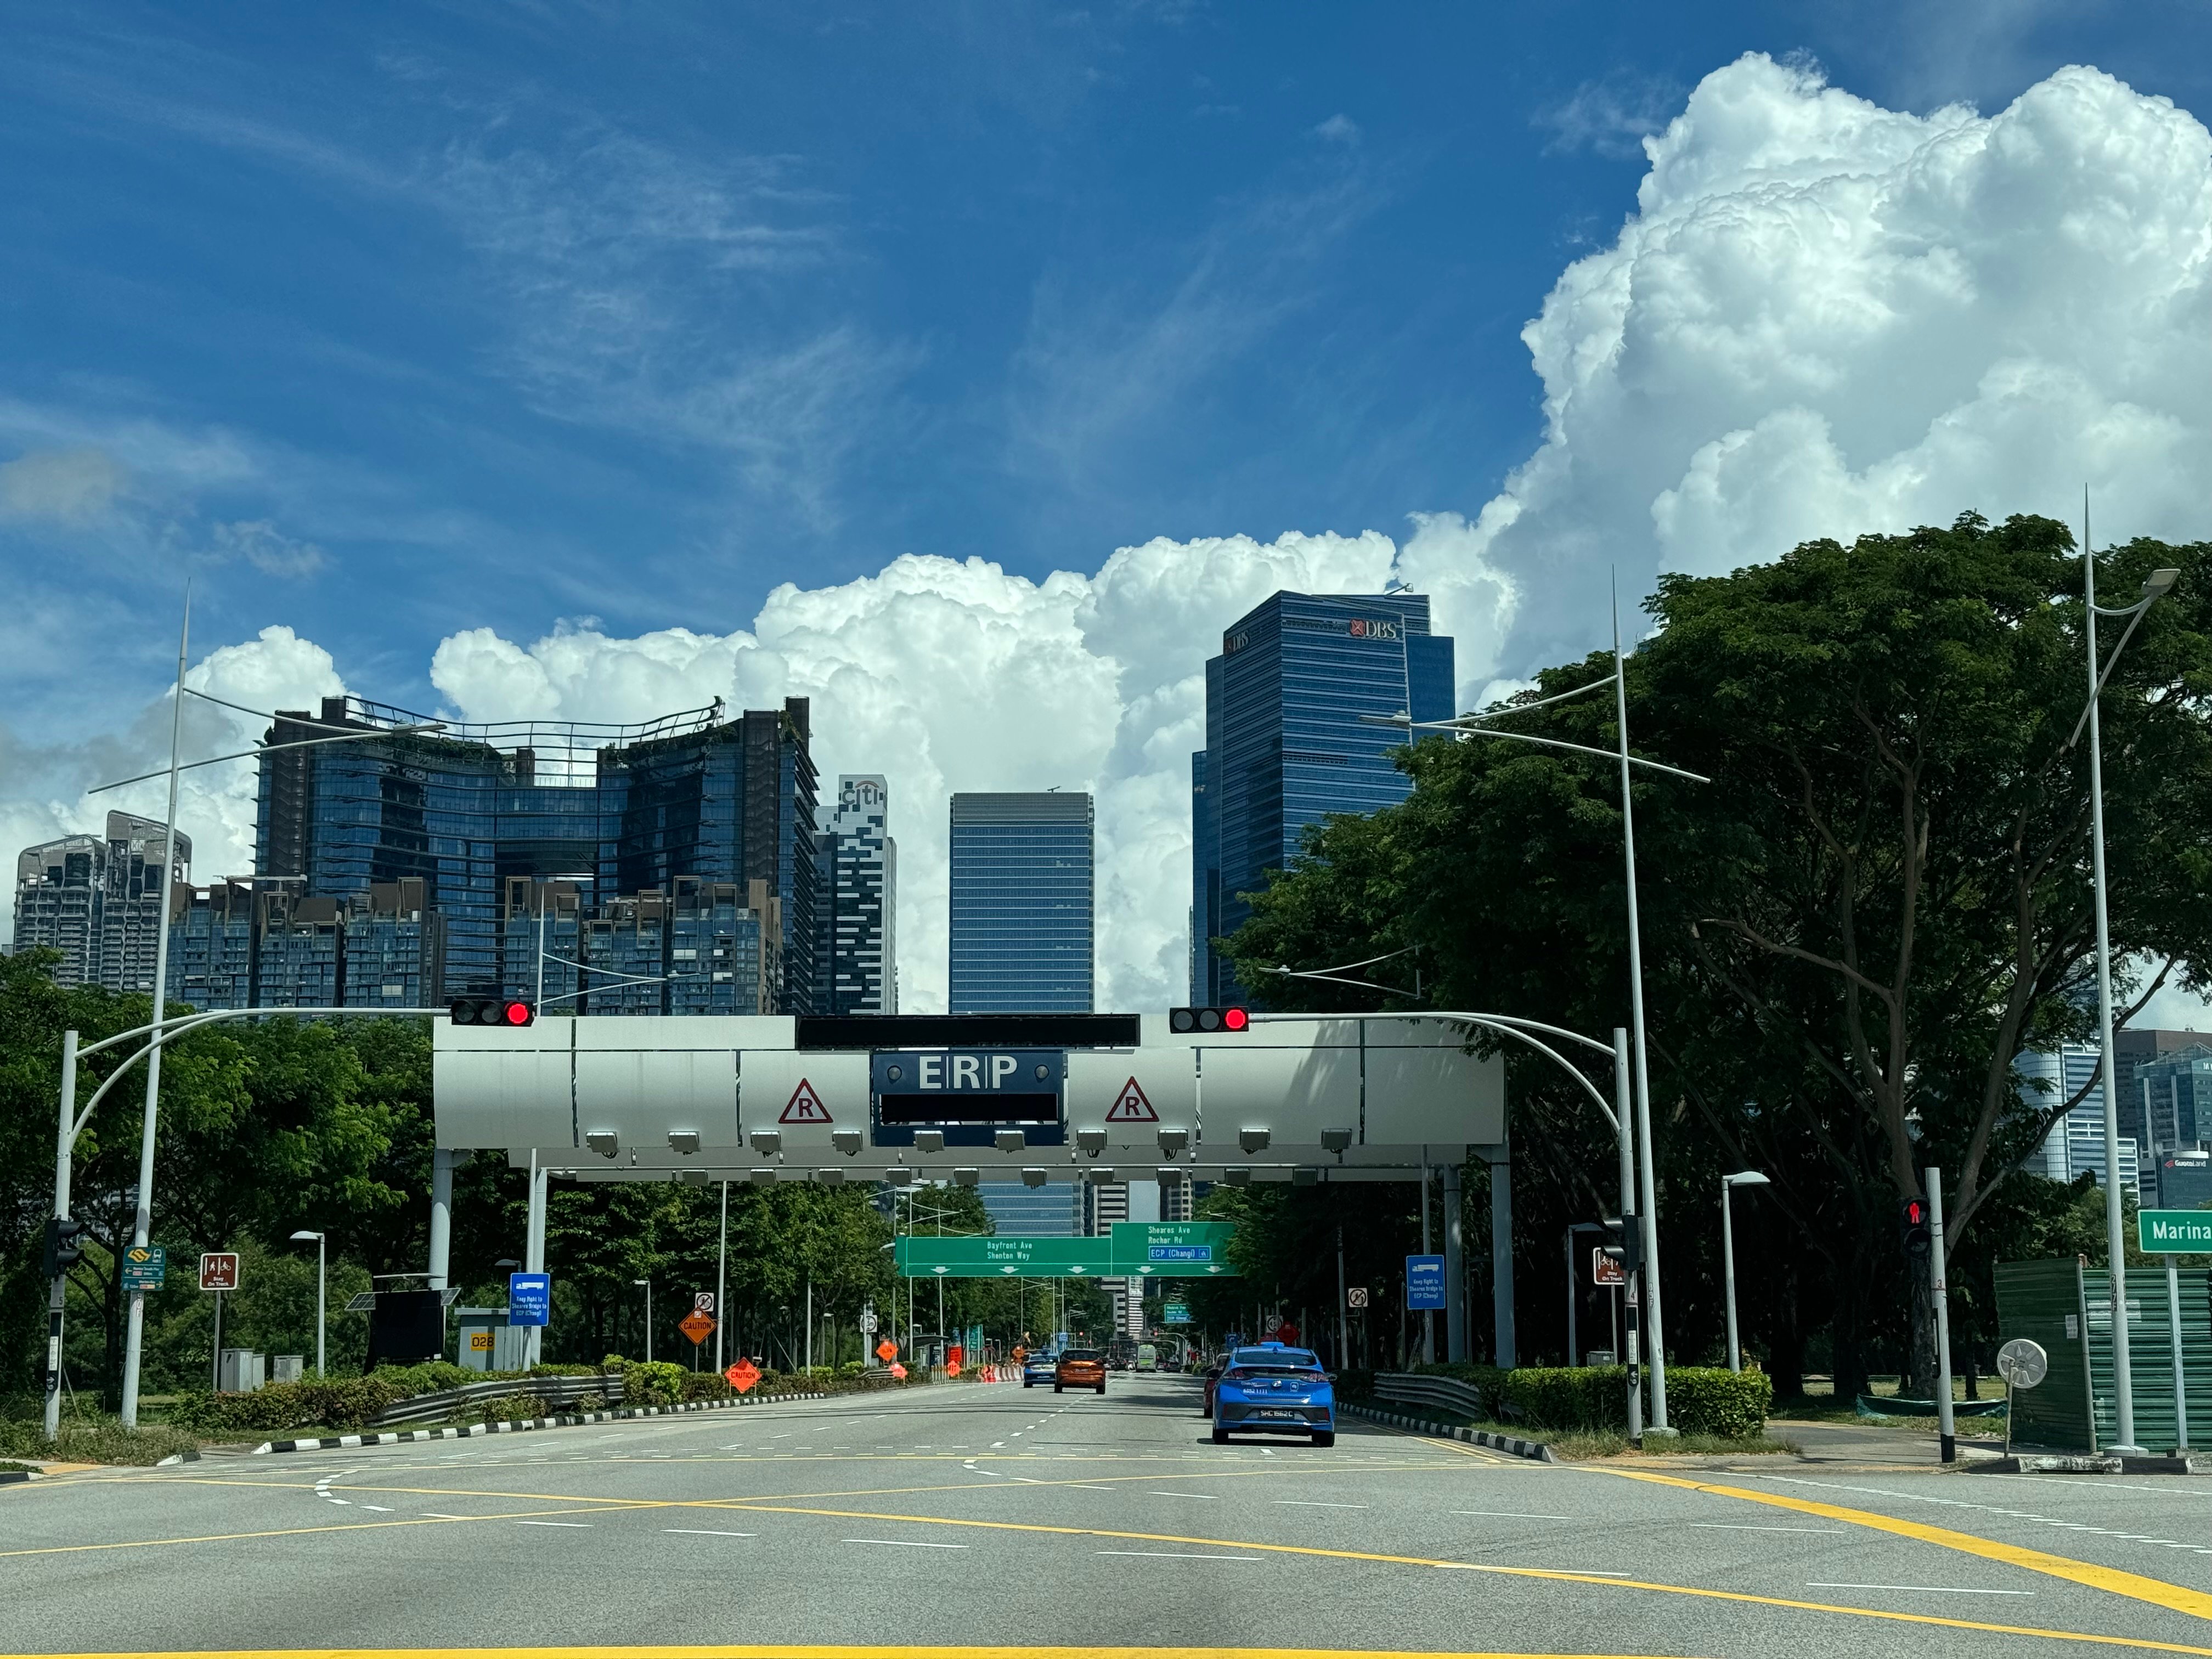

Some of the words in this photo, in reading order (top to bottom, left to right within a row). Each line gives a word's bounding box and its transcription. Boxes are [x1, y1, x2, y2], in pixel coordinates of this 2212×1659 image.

[1365, 620, 1397, 639] DBS
[842, 784, 878, 805] citi
[798, 1098, 814, 1118] R
[1125, 1096, 1141, 1116] R
[1148, 1226, 1175, 1234] Sheares
[1178, 1226, 1190, 1234] Ave
[2153, 1221, 2212, 1240] Marina
[1148, 1236, 1171, 1244] Rochor
[1174, 1236, 1183, 1244] Rd
[987, 1241, 1017, 1251] Bayfront
[1020, 1241, 1032, 1249] Ave
[987, 1251, 1014, 1260] Shenton
[1017, 1251, 1030, 1261] Way
[1151, 1249, 1165, 1257] ECP
[1168, 1249, 1195, 1259] (Changi)
[1937, 1279, 1942, 1288] 3
[59, 1296, 63, 1305] 5
[1630, 1292, 1635, 1301] 4
[684, 1321, 712, 1330] CAUTION
[472, 1336, 494, 1347] 028
